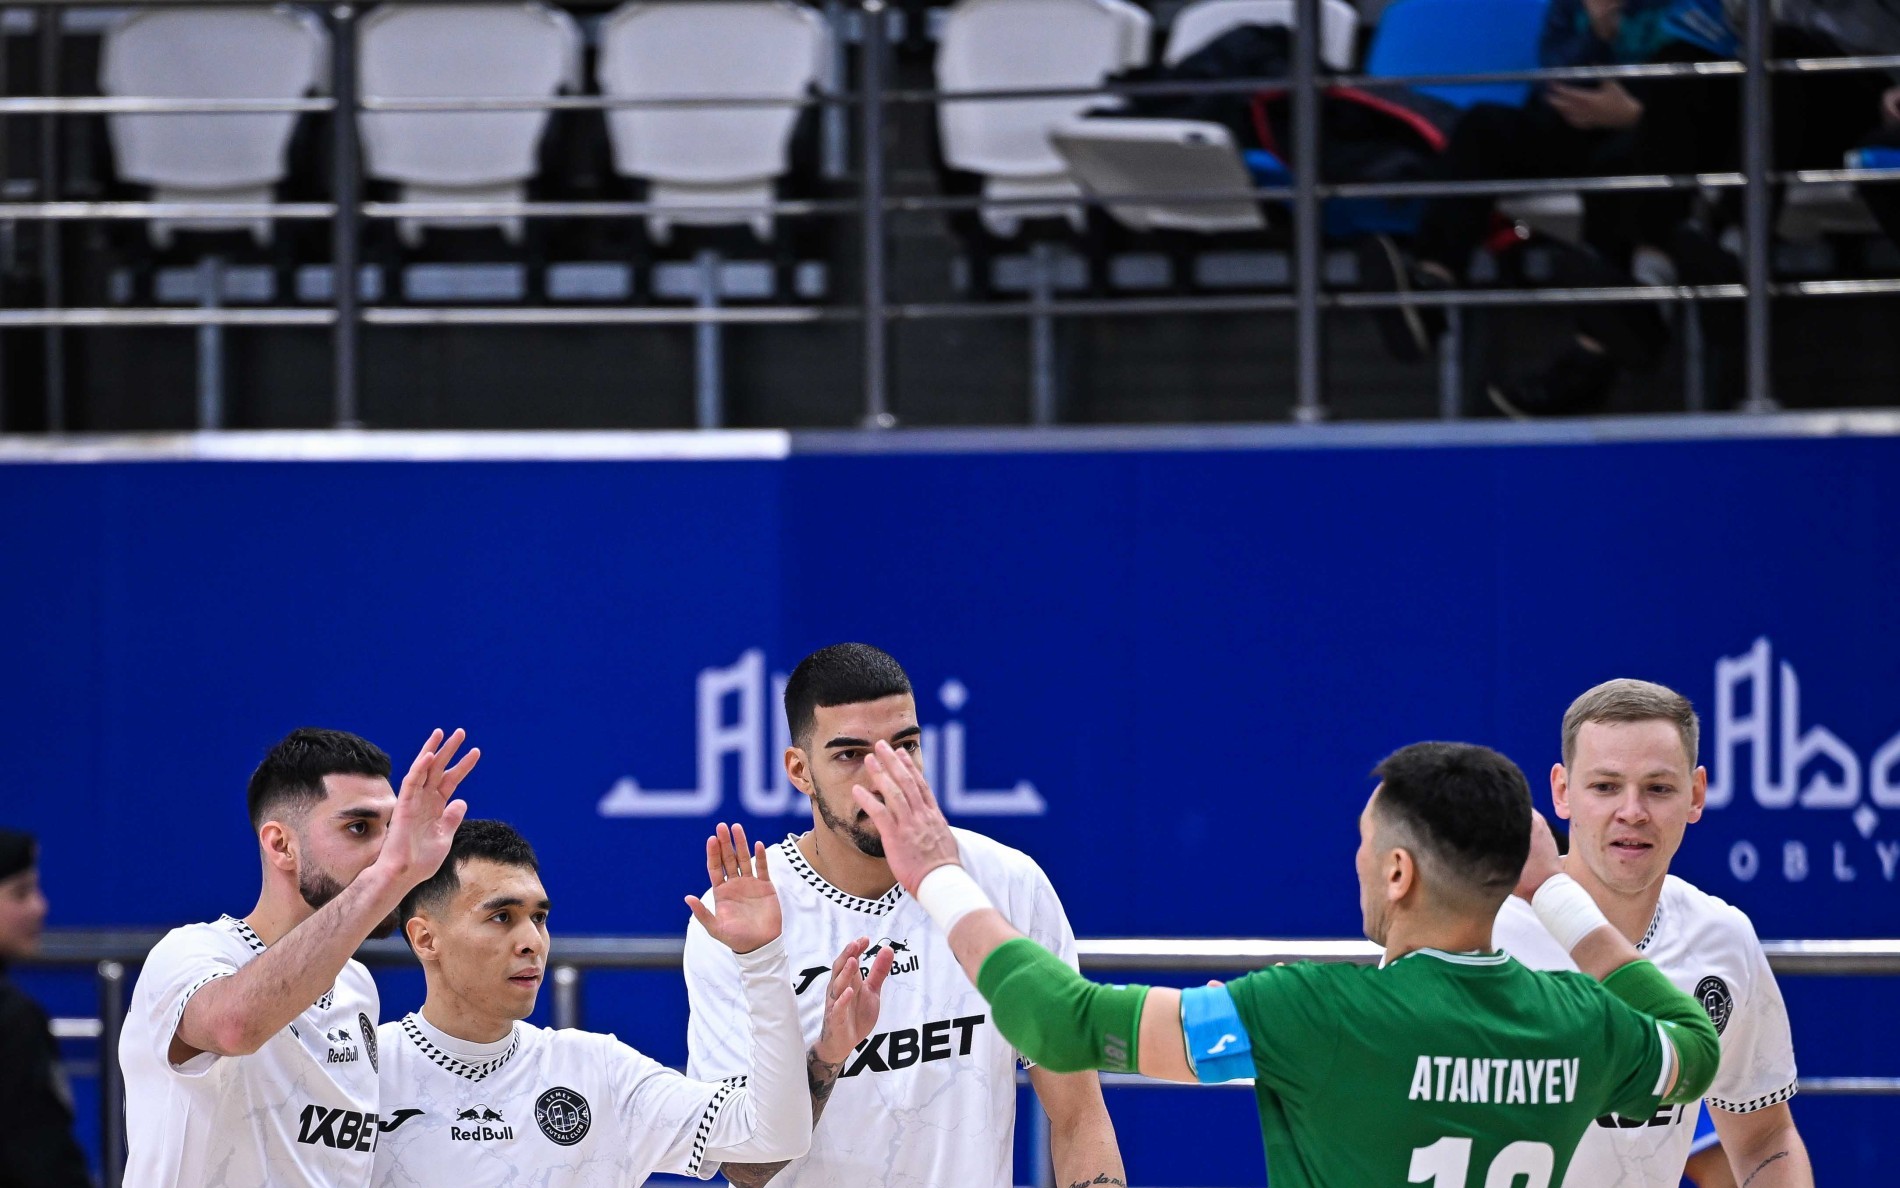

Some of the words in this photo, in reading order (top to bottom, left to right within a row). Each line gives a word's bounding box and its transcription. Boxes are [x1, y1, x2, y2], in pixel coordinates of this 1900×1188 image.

[838, 1013, 986, 1079] XBET
[545, 1092, 571, 1103] SEMEY
[1408, 1055, 1580, 1105] ATANTAYEV
